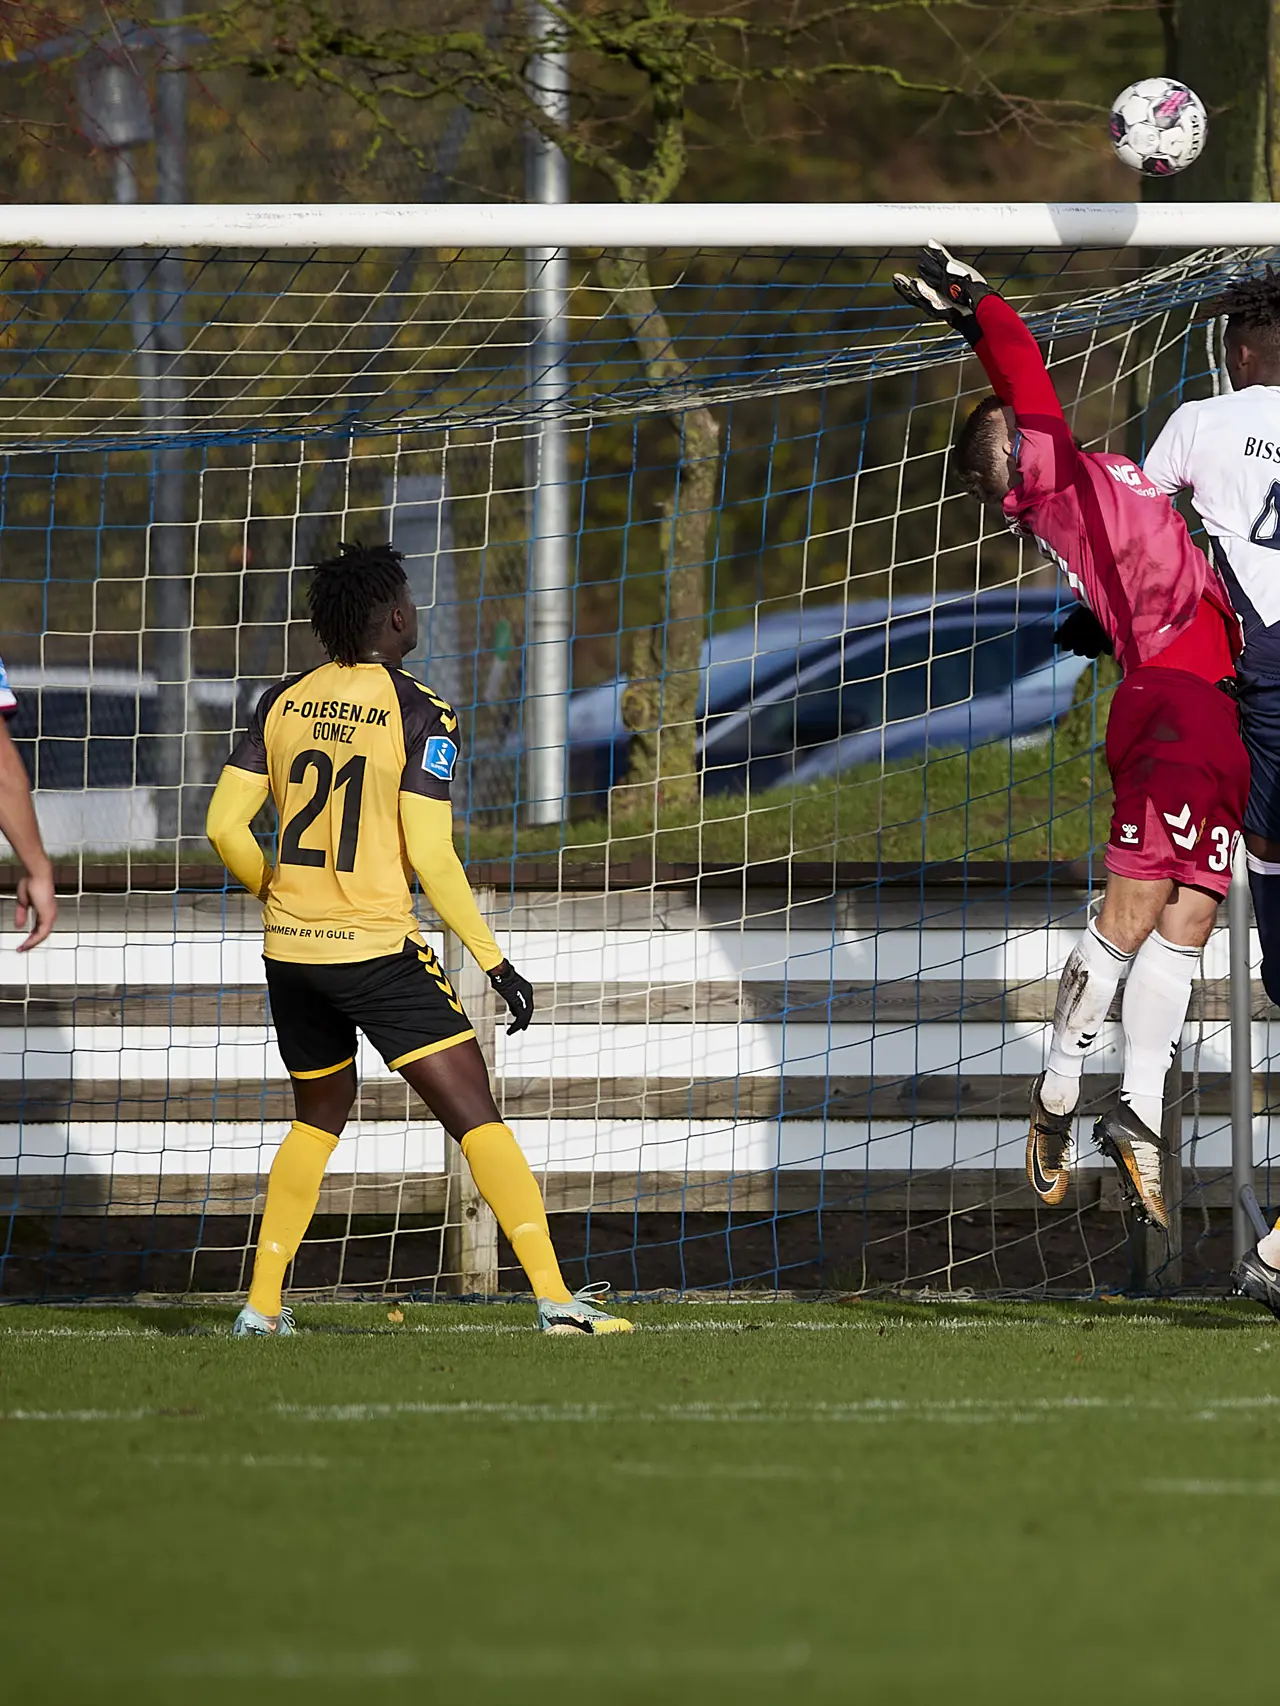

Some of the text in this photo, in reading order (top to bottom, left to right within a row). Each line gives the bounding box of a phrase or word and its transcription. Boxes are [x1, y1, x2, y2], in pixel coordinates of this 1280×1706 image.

[282, 700, 391, 727] P-OLESEN.DK
[313, 721, 357, 744] GOMEZ
[280, 749, 367, 873] 21
[299, 928, 312, 938] ER
[314, 929, 324, 938] VI
[326, 930, 355, 940] GULE
